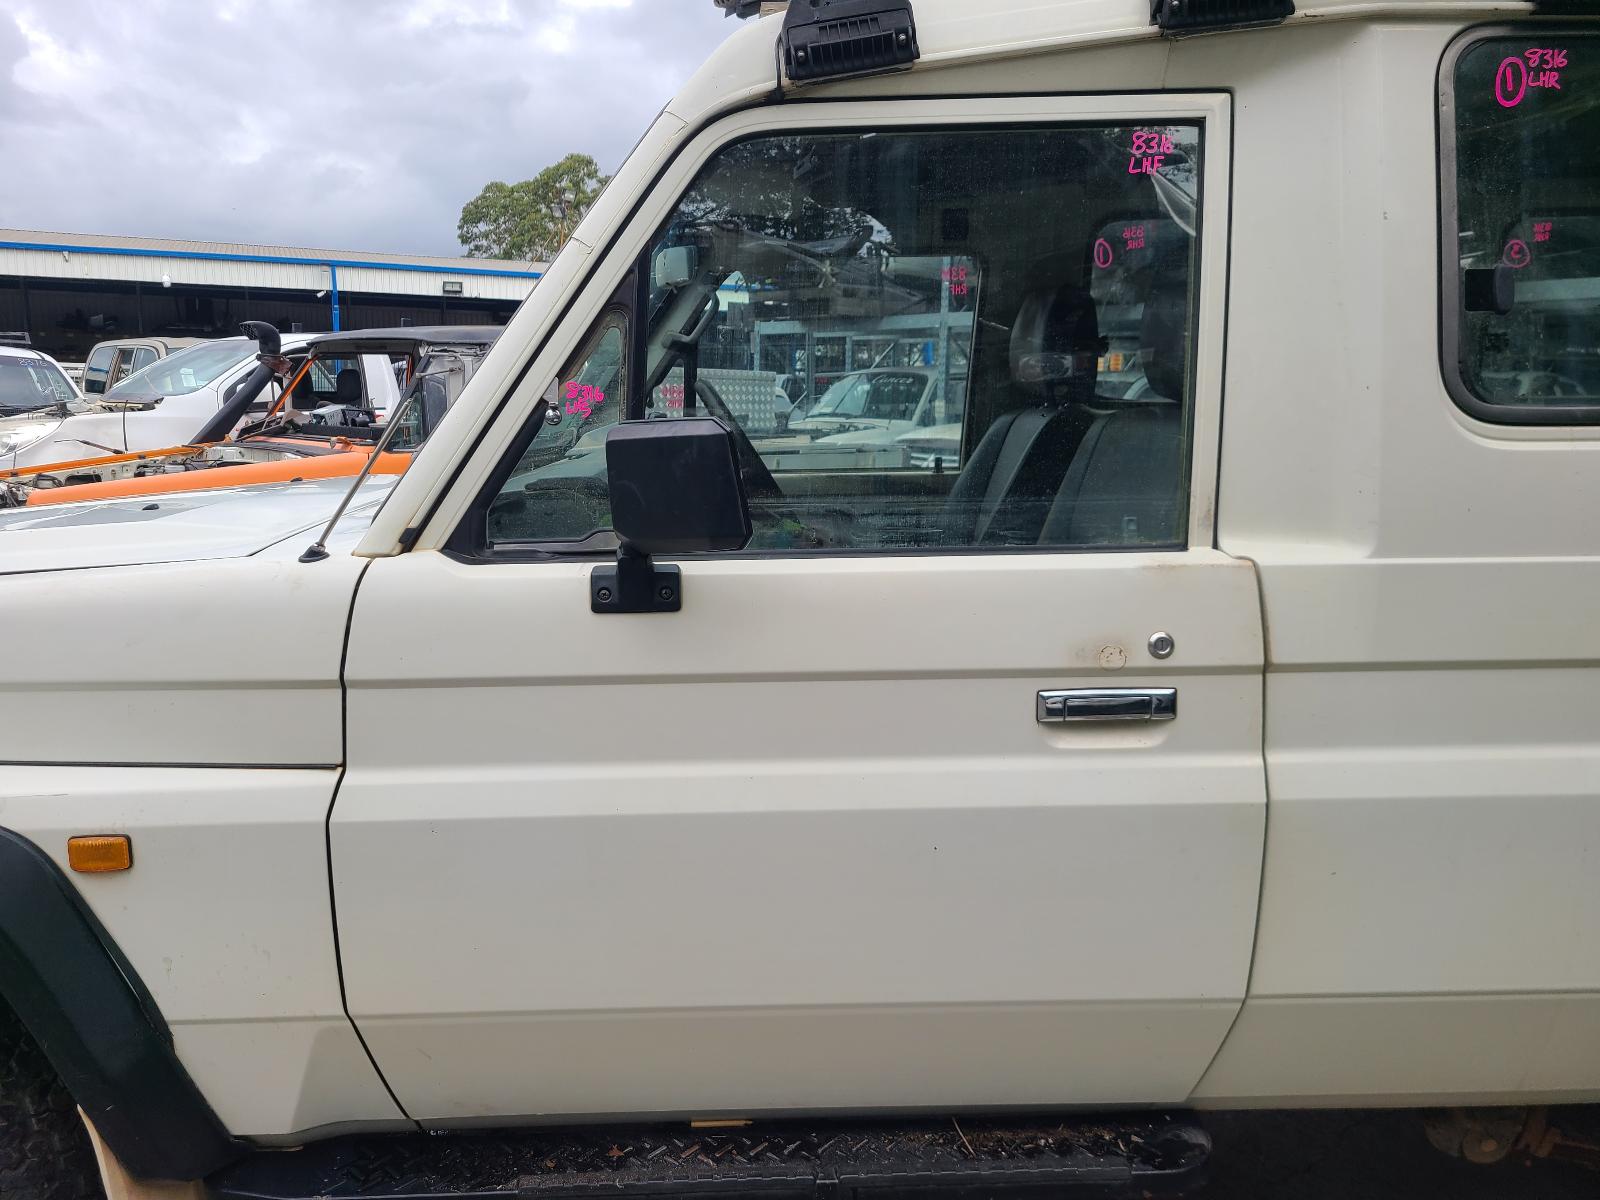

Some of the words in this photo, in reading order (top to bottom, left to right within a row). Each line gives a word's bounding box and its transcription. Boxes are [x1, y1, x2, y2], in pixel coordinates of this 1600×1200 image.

[1523, 48, 1568, 69] 8316
[1527, 71, 1561, 90] LHR
[1132, 131, 1173, 155] 8316
[1128, 156, 1165, 175] LHF
[566, 381, 604, 403] 8316
